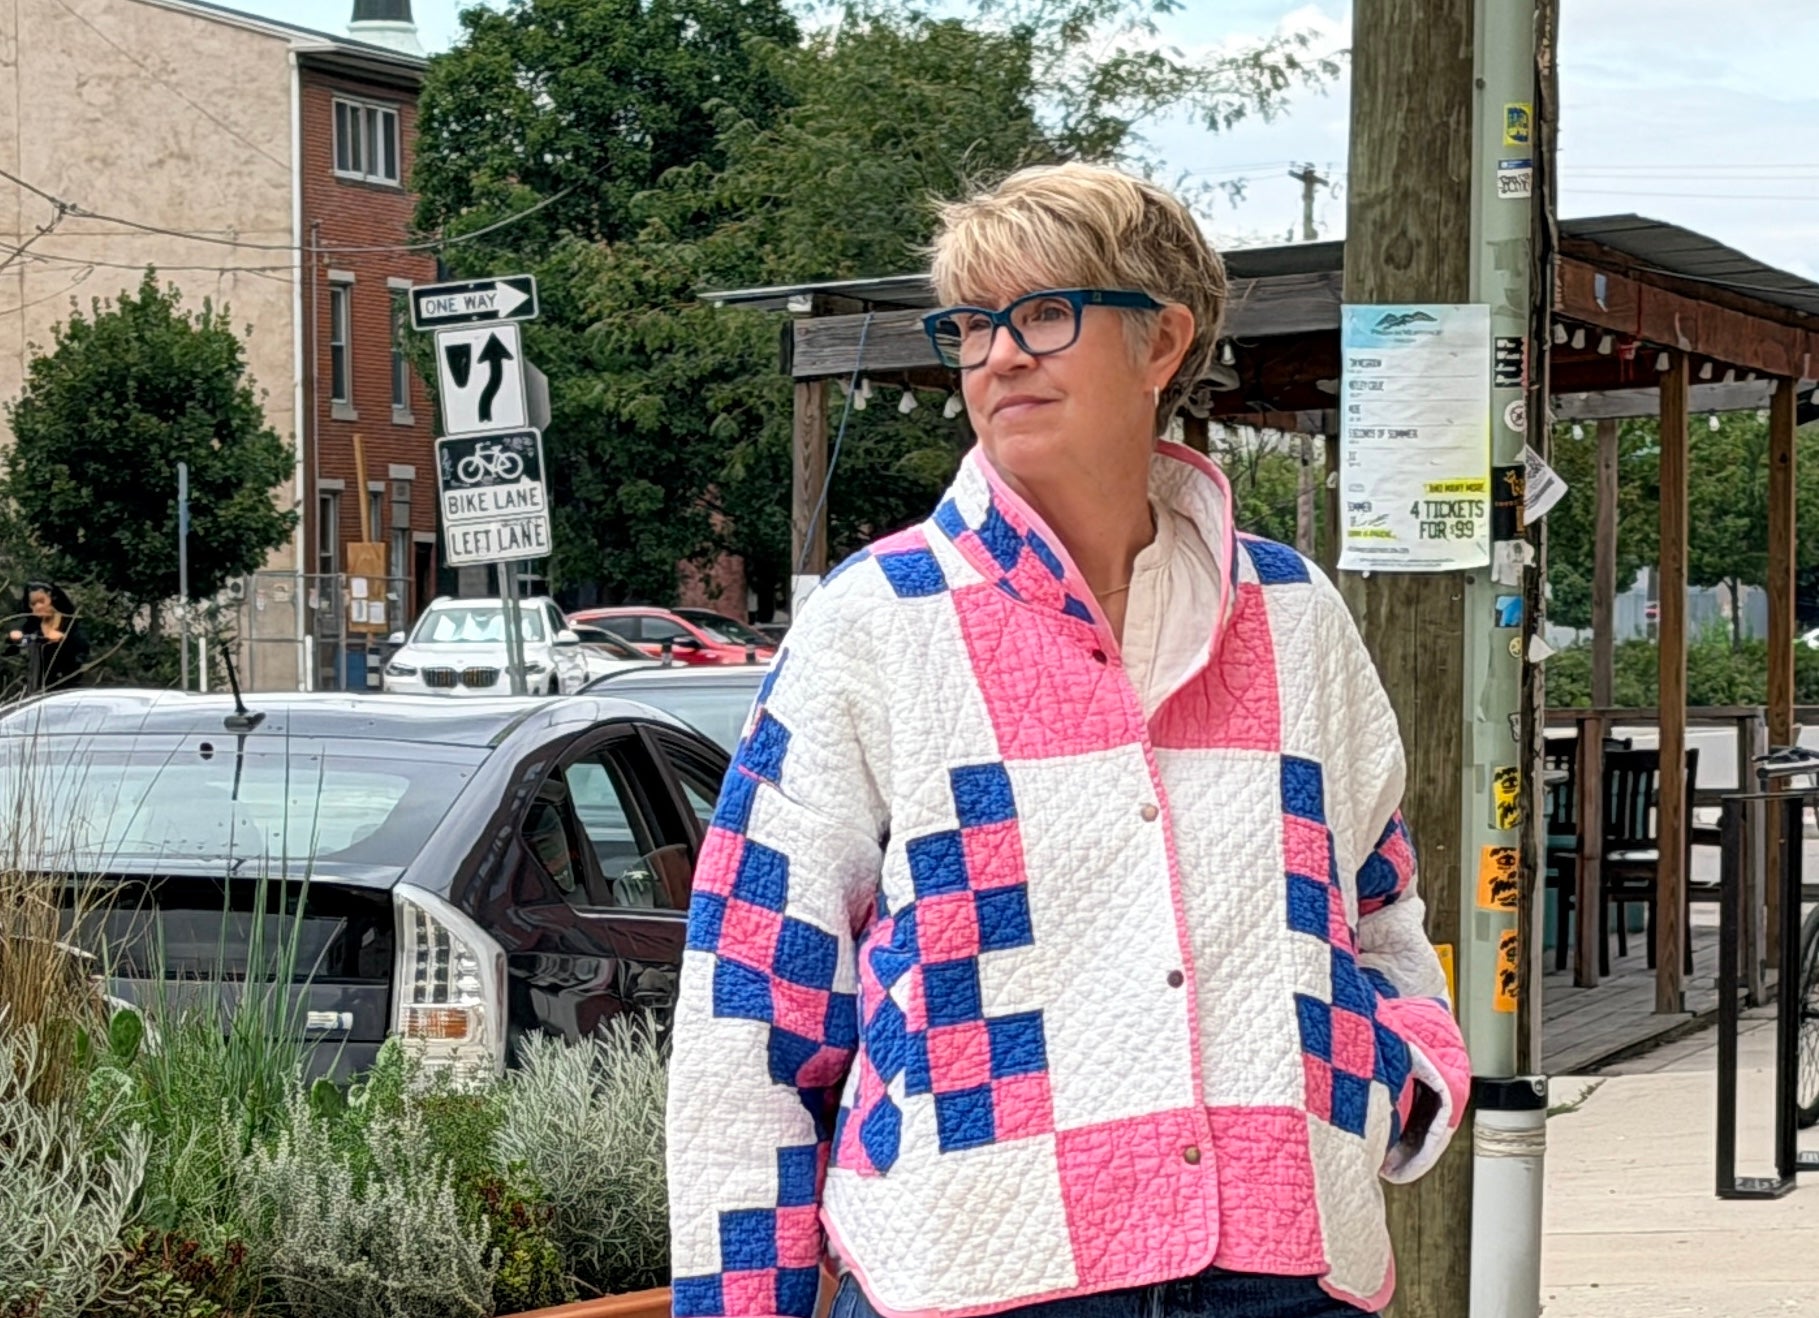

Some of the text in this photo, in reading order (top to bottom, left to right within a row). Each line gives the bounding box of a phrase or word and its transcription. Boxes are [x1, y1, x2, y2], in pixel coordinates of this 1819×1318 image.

[425, 293, 497, 315] ONE WAY
[448, 487, 541, 515] BIKE LANE
[1410, 499, 1485, 519] 4 TICKETS
[451, 522, 546, 556] LEFT LANE
[1420, 520, 1475, 540] FOR $99
